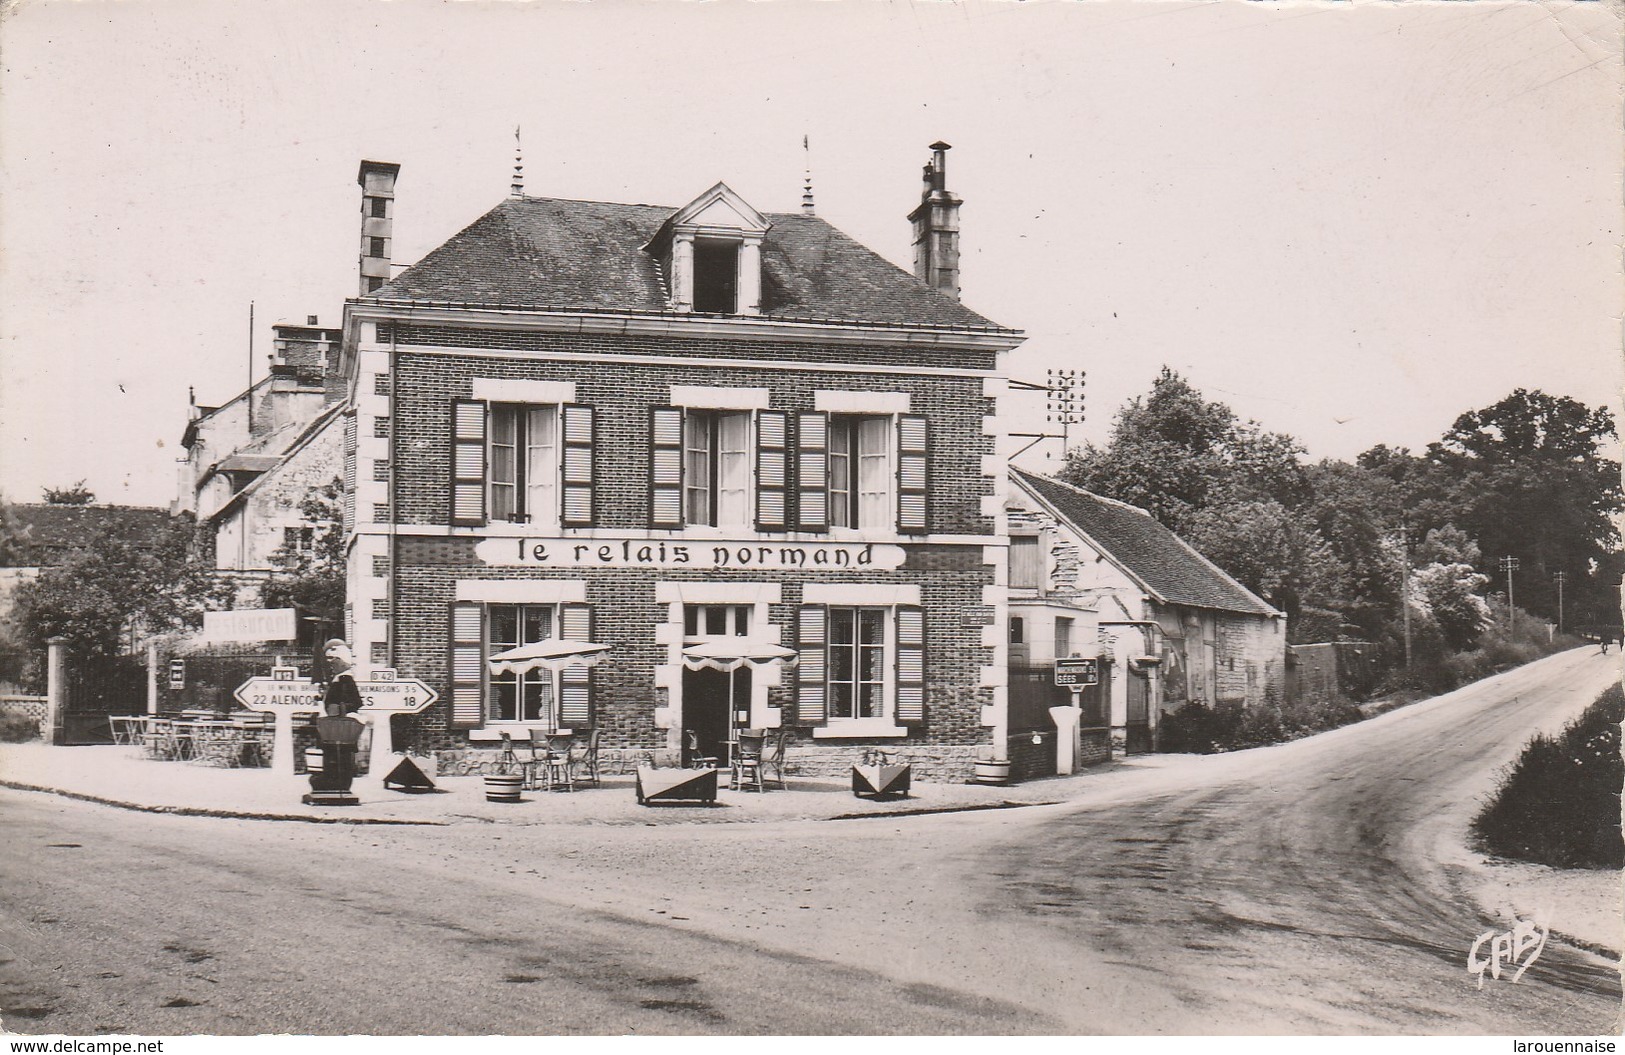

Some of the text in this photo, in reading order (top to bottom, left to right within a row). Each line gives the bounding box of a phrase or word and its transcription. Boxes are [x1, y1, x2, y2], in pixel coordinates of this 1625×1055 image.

[518, 538, 873, 567] le relais normand
[253, 695, 314, 706] 22 ALENCO
[404, 696, 416, 706] 18
